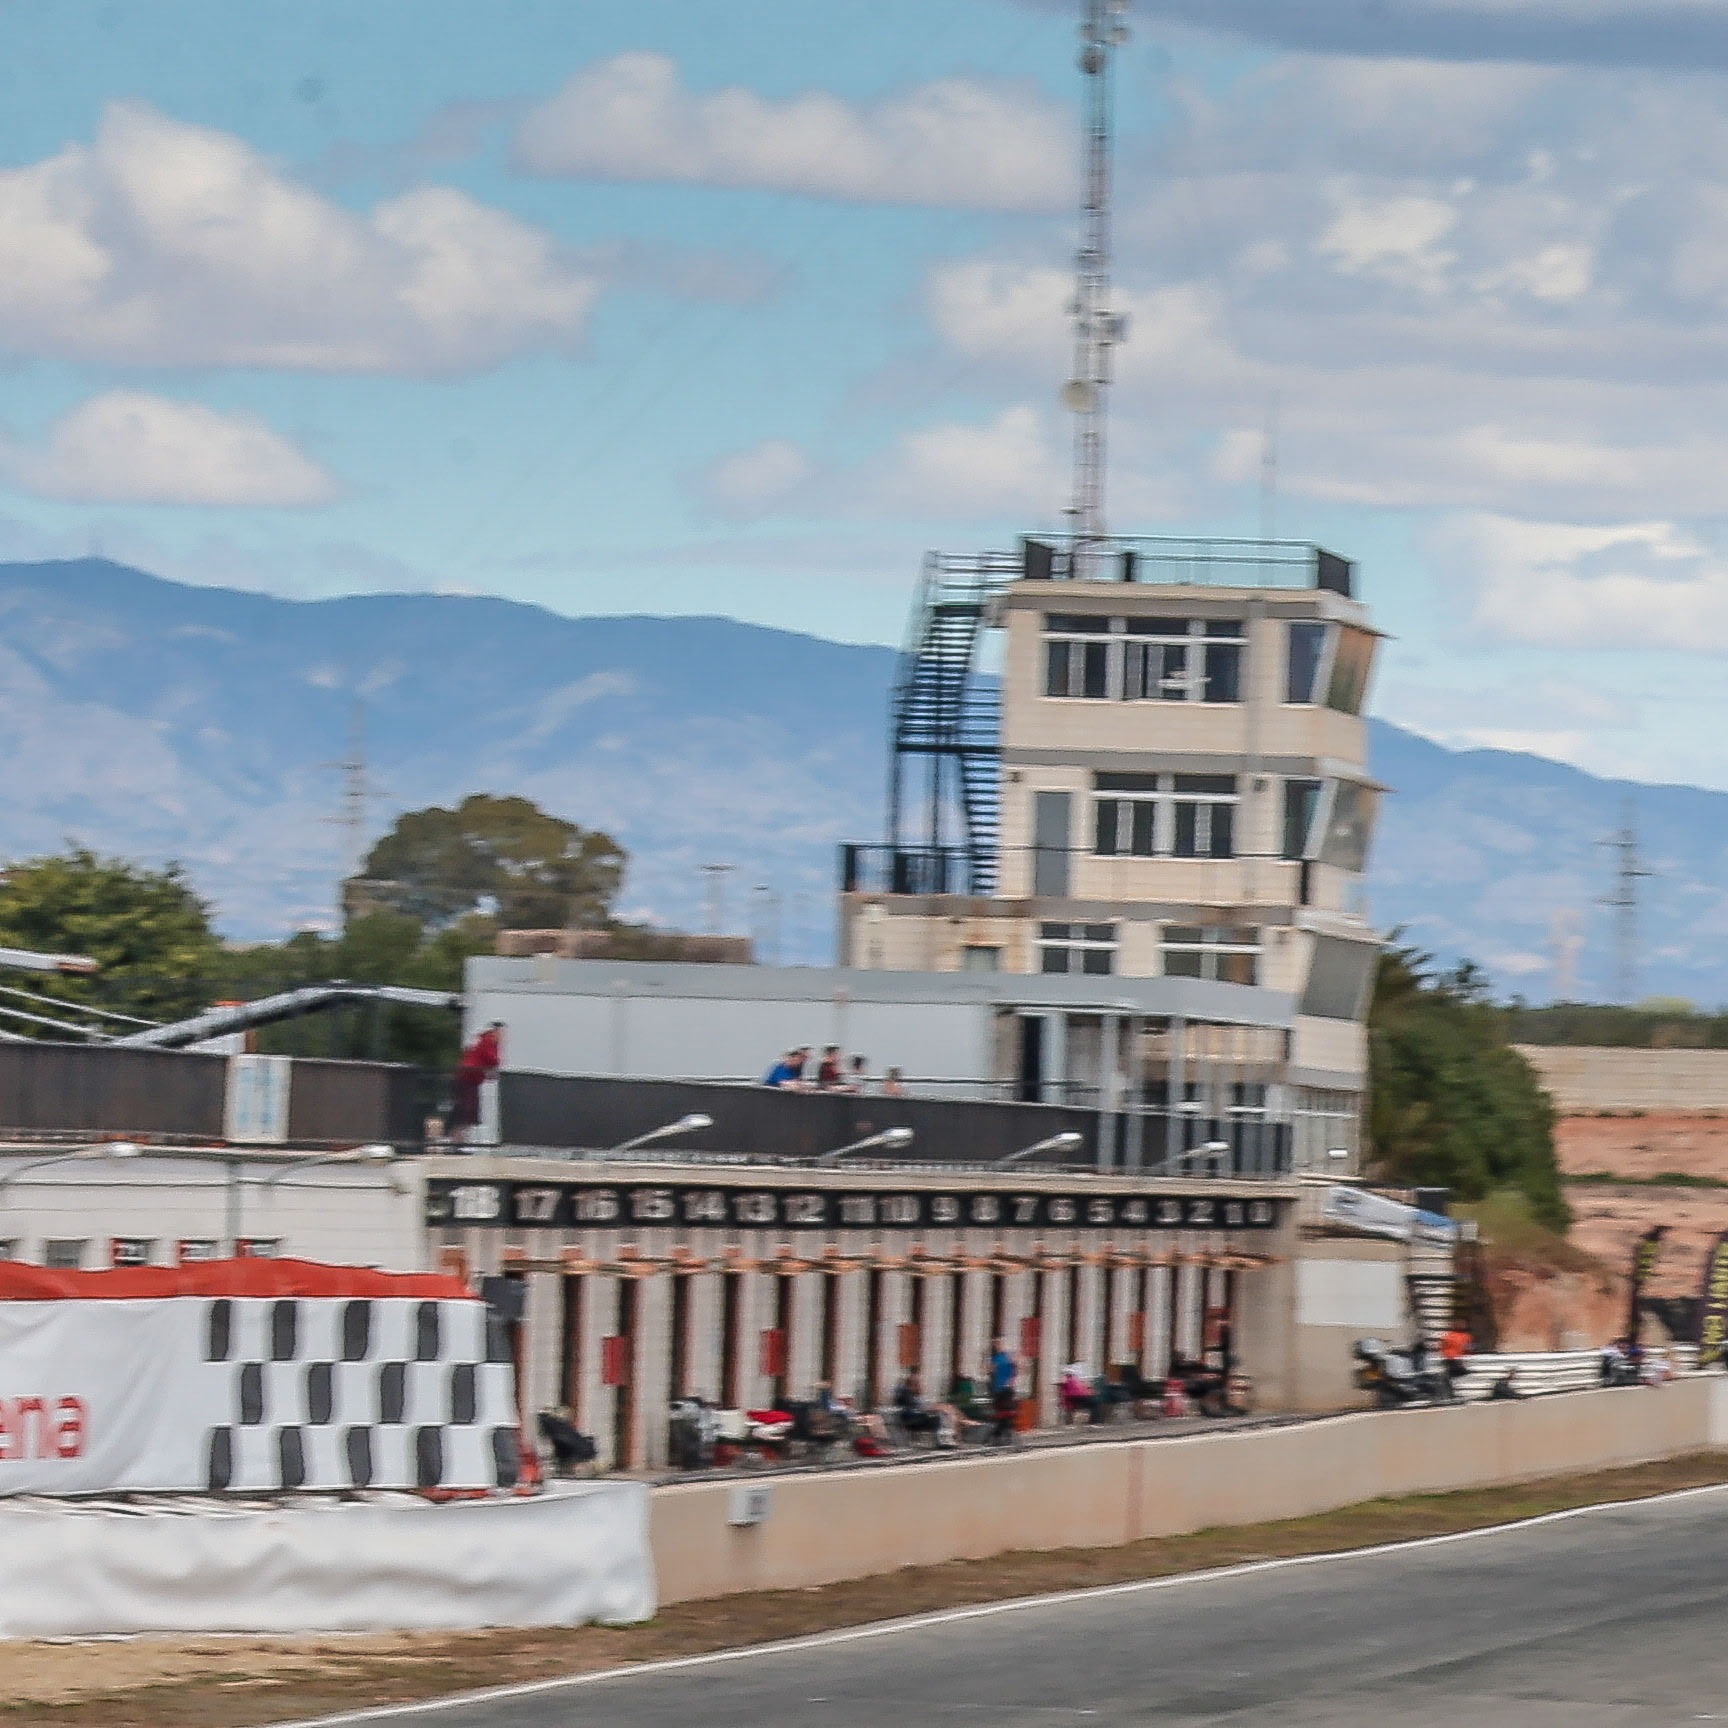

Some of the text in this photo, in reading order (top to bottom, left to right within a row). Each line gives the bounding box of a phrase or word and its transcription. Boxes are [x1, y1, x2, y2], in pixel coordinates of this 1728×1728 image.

[450, 1186, 500, 1219] 18
[513, 1188, 562, 1220] 17
[571, 1188, 620, 1221] 16
[628, 1188, 676, 1220] 15
[683, 1191, 727, 1221] 14
[732, 1193, 778, 1222] 13
[785, 1194, 826, 1223] 12
[930, 1196, 960, 1222] 9
[969, 1196, 1000, 1222] 8
[1014, 1197, 1039, 1222] 7
[1048, 1198, 1077, 1222] 6
[1087, 1199, 1115, 1223] 5
[1120, 1199, 1148, 1223] 4
[1156, 1200, 1183, 1223] 3
[1187, 1200, 1215, 1223] 2
